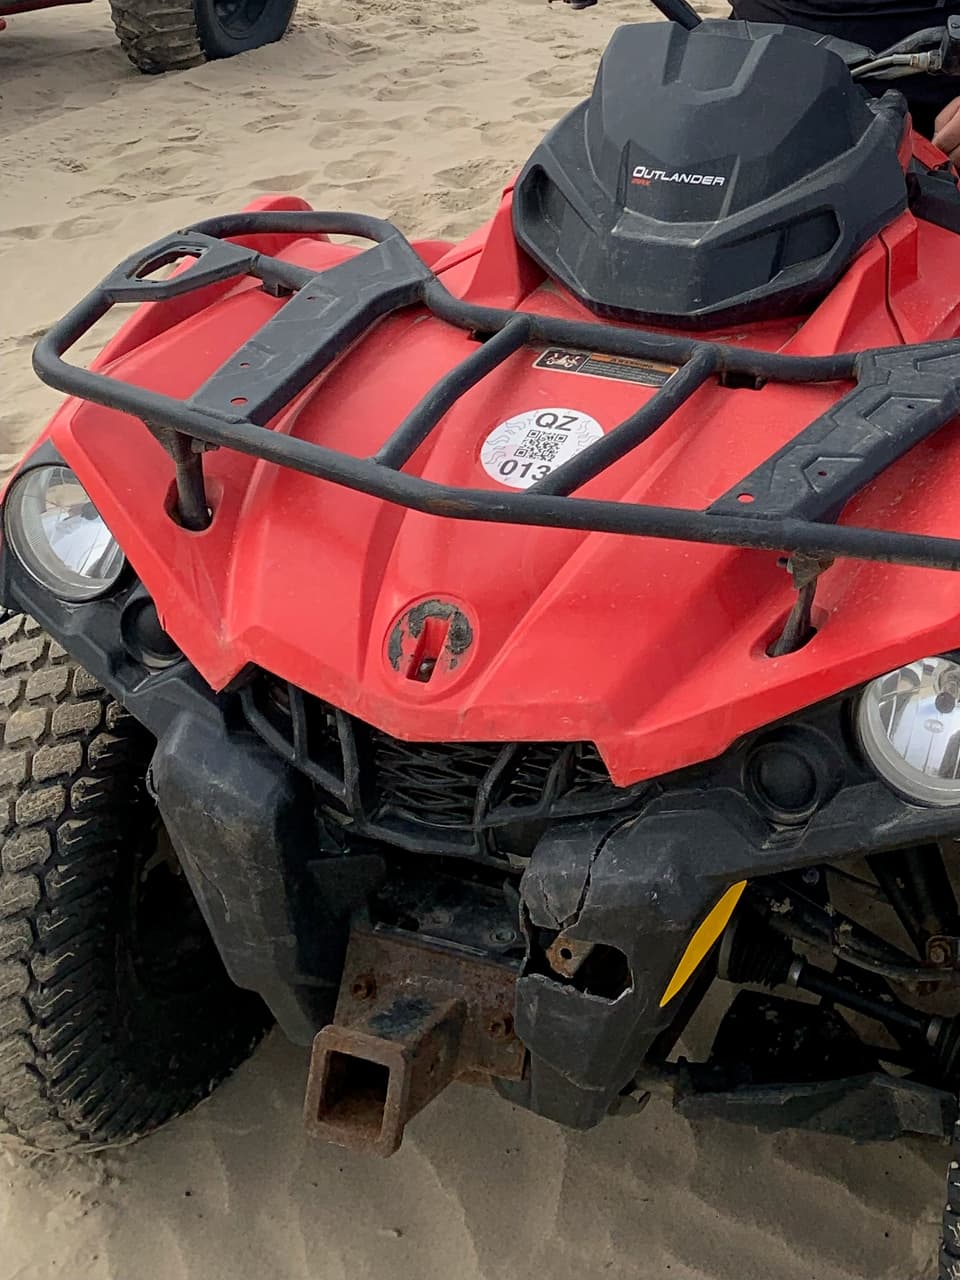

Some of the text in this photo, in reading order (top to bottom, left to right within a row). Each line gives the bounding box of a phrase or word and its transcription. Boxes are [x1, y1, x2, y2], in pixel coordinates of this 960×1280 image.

[632, 166, 725, 186] OUTLANDER
[535, 412, 579, 432] QZ
[499, 459, 551, 481] 013
